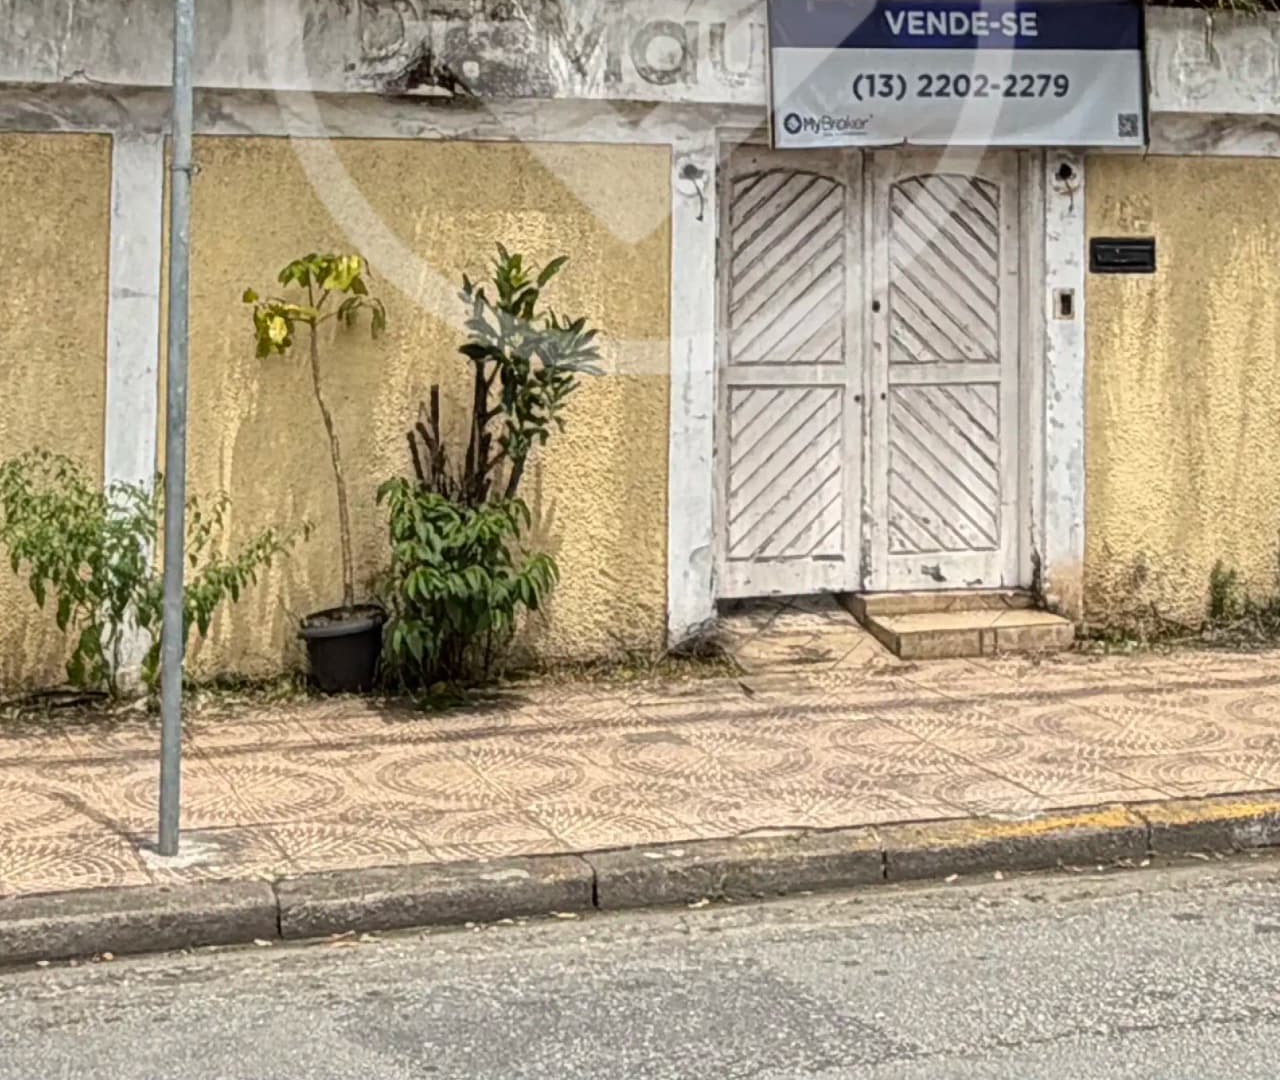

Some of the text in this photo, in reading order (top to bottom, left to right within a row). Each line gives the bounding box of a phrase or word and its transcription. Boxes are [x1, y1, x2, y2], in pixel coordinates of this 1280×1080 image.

[884, 10, 1039, 37] VENDE-SE
[852, 72, 1070, 101] (13) 2202-2279
